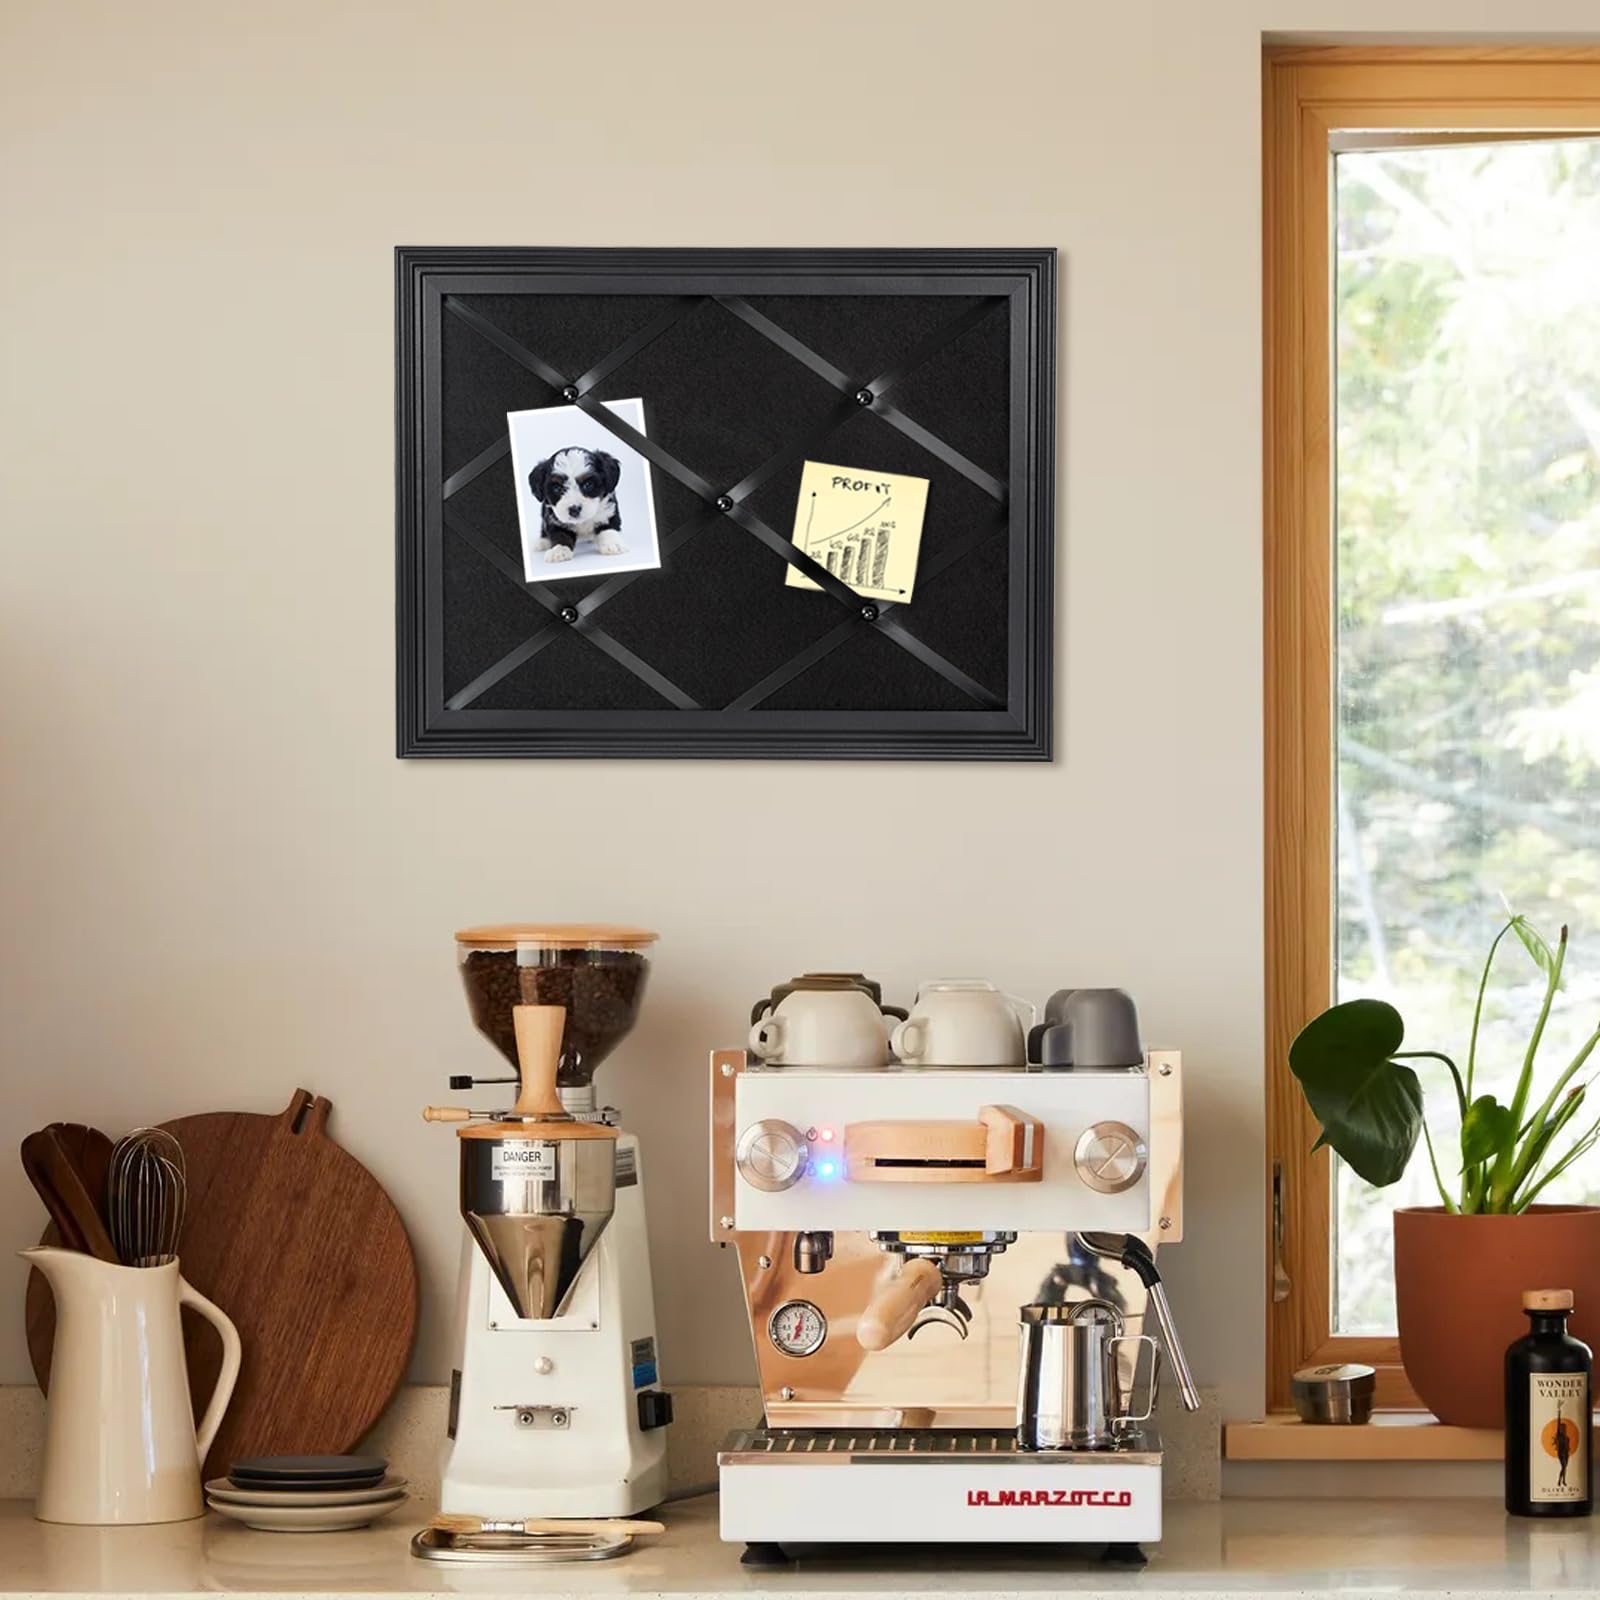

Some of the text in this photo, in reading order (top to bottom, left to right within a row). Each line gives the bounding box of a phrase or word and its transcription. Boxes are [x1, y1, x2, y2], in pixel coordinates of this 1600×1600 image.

[832, 476, 891, 495] PROFIT
[503, 1151, 542, 1163] DANGER
[1537, 1379, 1583, 1388] WONDER
[1540, 1389, 1582, 1397] VALLEY
[967, 1490, 1132, 1507] LA MARZOCCO
